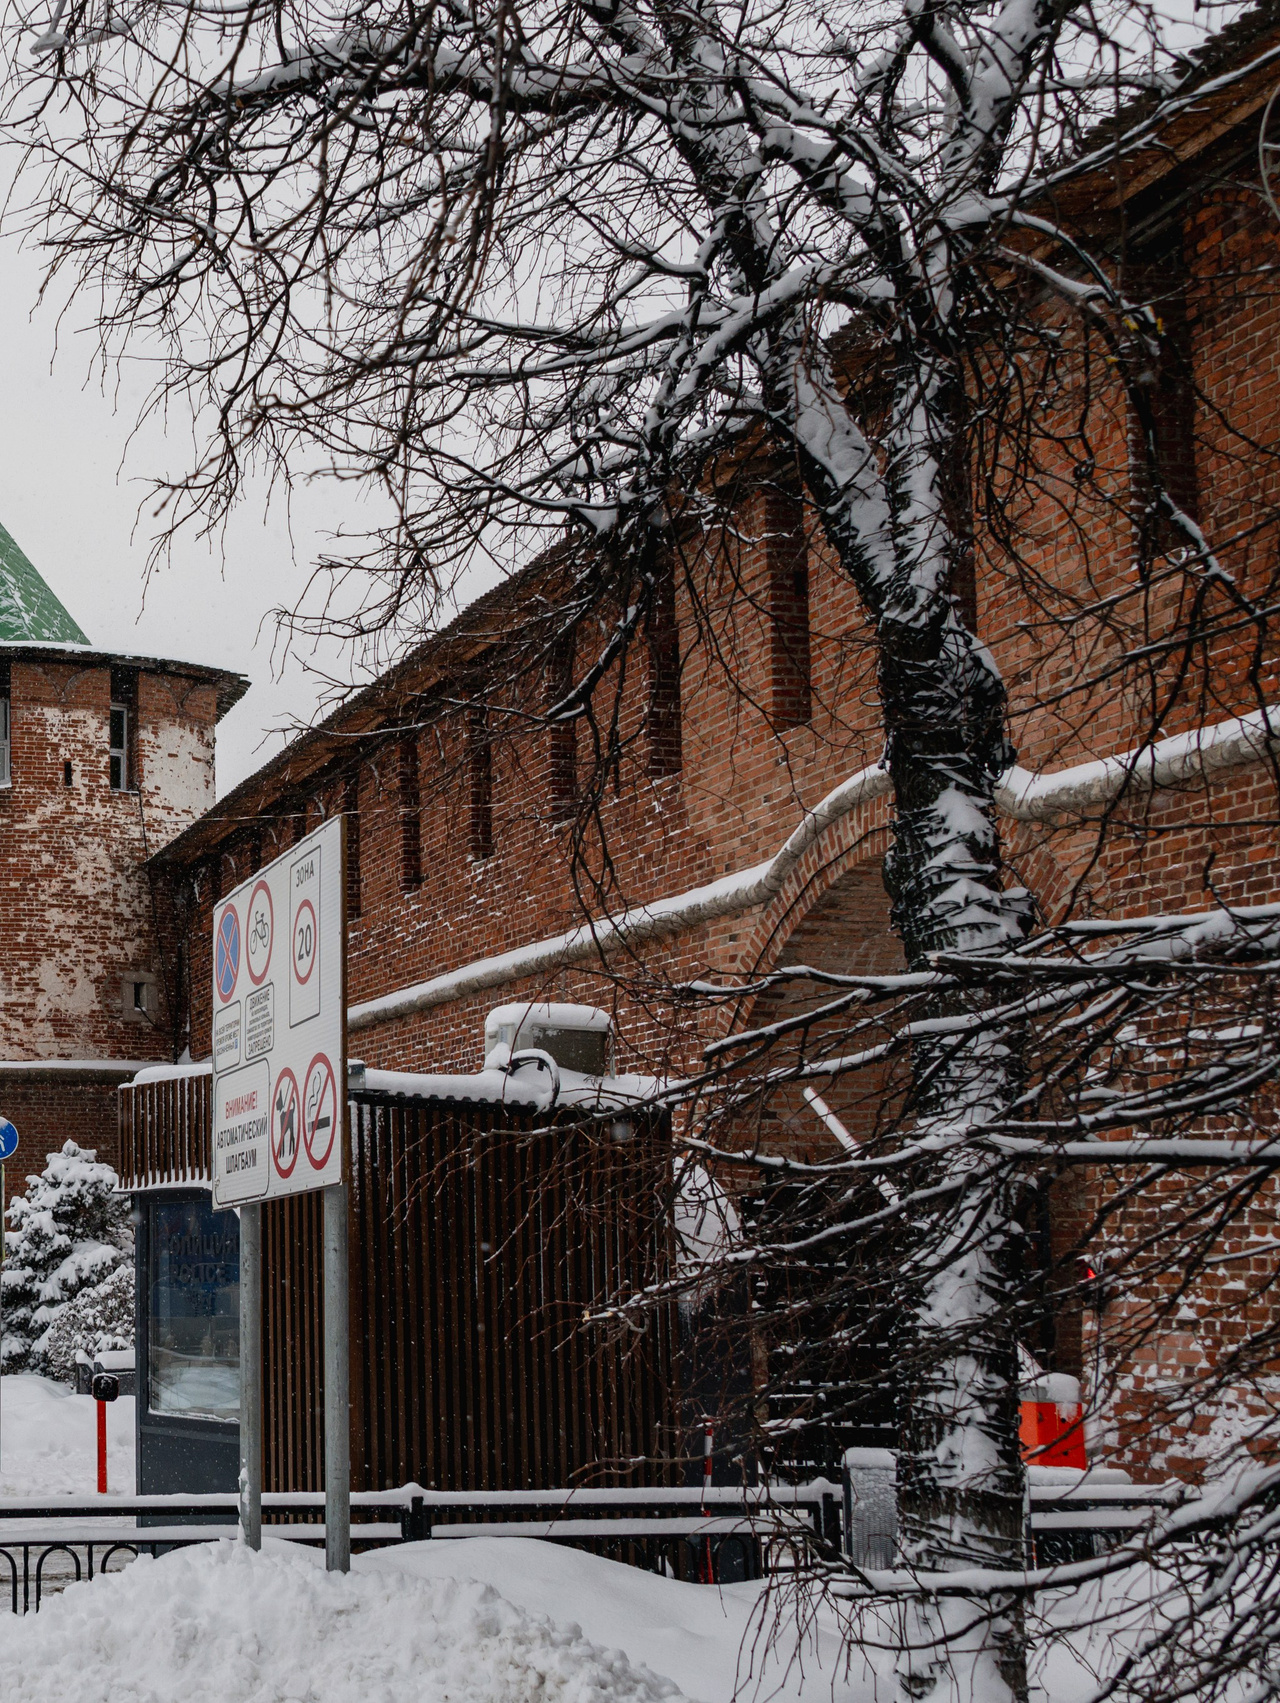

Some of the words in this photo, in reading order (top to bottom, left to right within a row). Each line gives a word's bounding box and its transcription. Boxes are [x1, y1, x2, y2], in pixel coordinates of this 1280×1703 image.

[296, 860, 314, 888] ЗОНА
[298, 924, 312, 961] 20
[250, 989, 270, 1010] ДВИЖЕНИЕ
[248, 1034, 271, 1055] ЗАПРЕЩЕНО
[226, 1090, 257, 1119] ВНИМАНИЕ!
[217, 1113, 267, 1148] АВТОМАТИЧЕСКИЙ
[226, 1148, 257, 1174] ШЛАГБАУМ
[170, 1264, 225, 1284] POLICE
